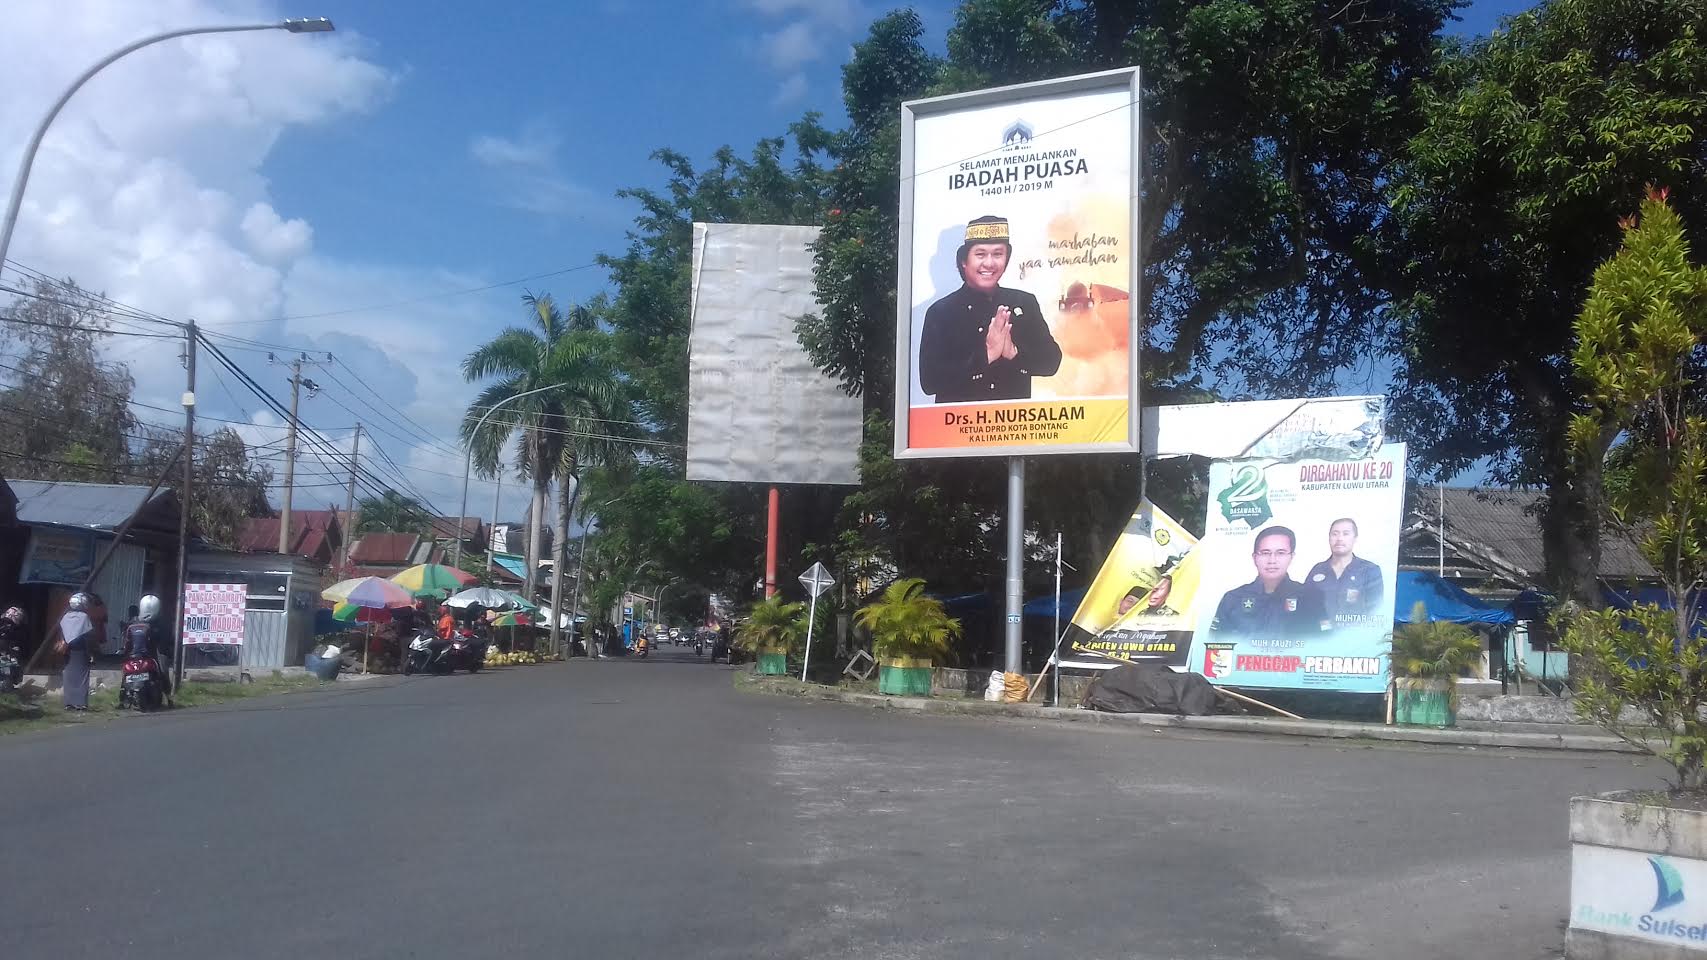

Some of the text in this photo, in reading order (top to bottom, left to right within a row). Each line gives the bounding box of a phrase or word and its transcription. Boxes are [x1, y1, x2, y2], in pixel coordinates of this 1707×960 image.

[959, 158, 1001, 171] SELAMAT
[1003, 148, 1077, 165] MENJALANKAN
[948, 158, 1088, 190] IBADAH PUASA
[980, 186, 1002, 196] 1440
[1004, 185, 1011, 194] H
[1019, 182, 1042, 192] 2019
[1044, 180, 1053, 189] M
[1048, 232, 1118, 250] marhaban
[1019, 248, 1118, 280] yaa ramadhan
[944, 406, 1085, 425] Drs. H. NURSALAM
[959, 422, 1068, 434] KETUA DPRD KOTA BONTANG
[969, 431, 1059, 442] KALIMANTAN TIMUR
[1299, 461, 1393, 482] DIRGAHAYU KE 20
[1302, 480, 1389, 491] KABUPATEN LUWU UTARA
[186, 616, 209, 631] ROMZI
